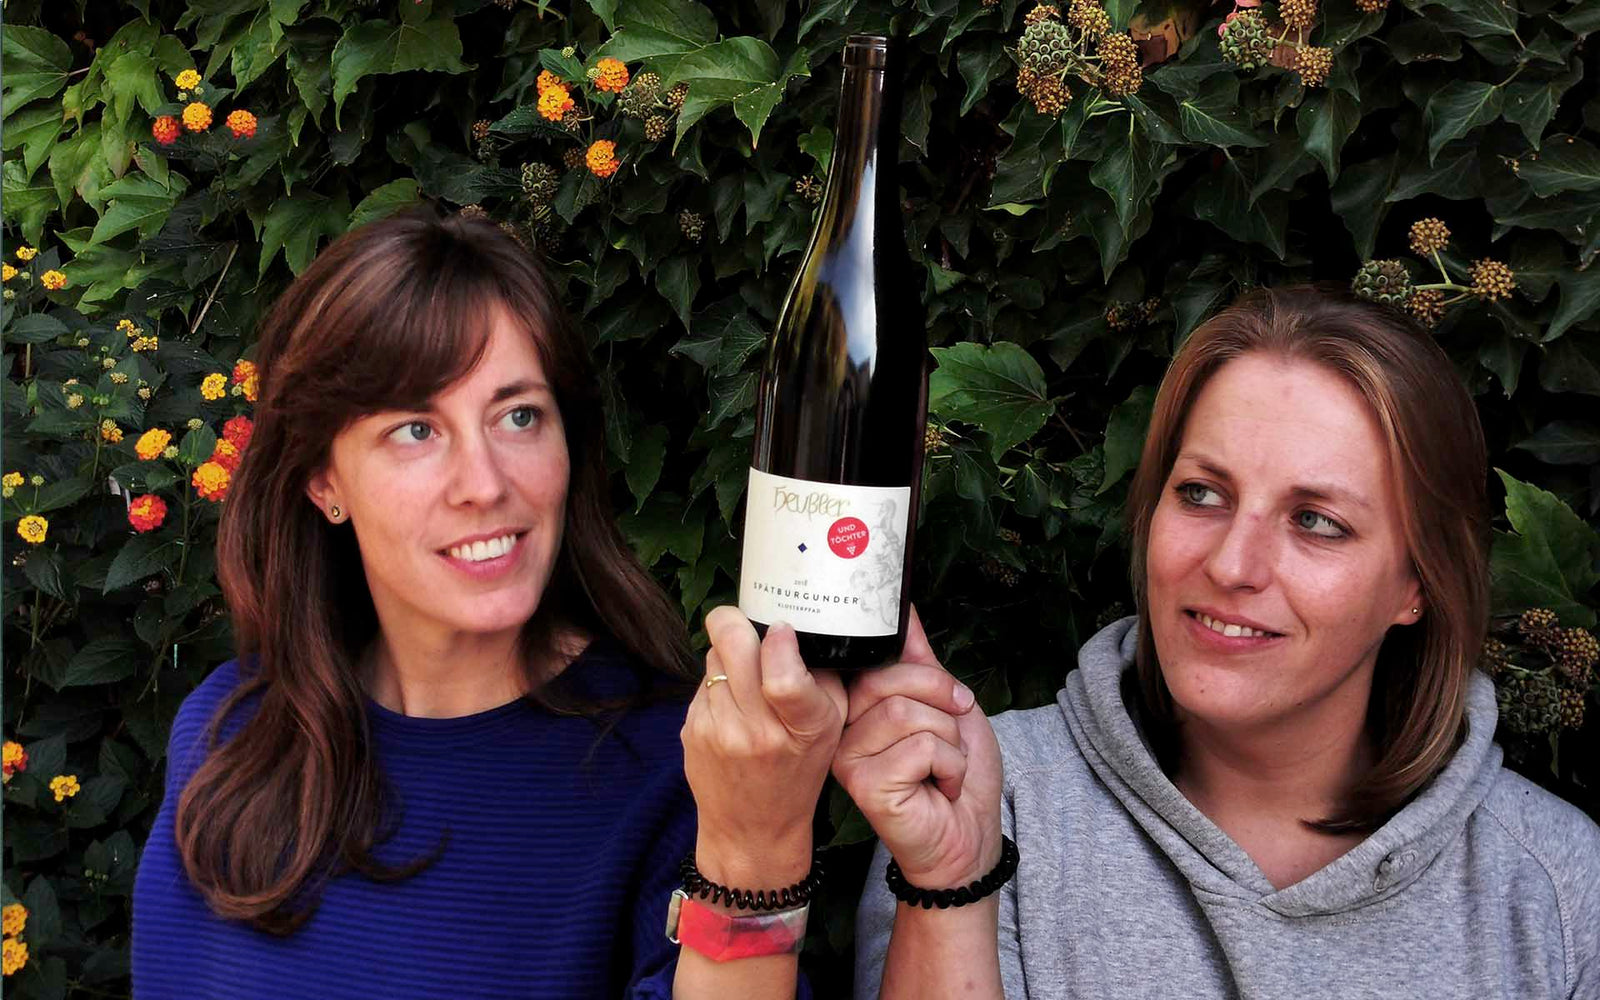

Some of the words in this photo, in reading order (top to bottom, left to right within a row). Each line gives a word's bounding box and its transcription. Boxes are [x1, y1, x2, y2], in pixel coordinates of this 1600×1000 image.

[837, 523, 856, 533] UND
[830, 530, 867, 544] TÖCHTER
[753, 581, 859, 604] SPÄTBURGUNDER
[777, 602, 821, 613] KLOSTERPFAD
